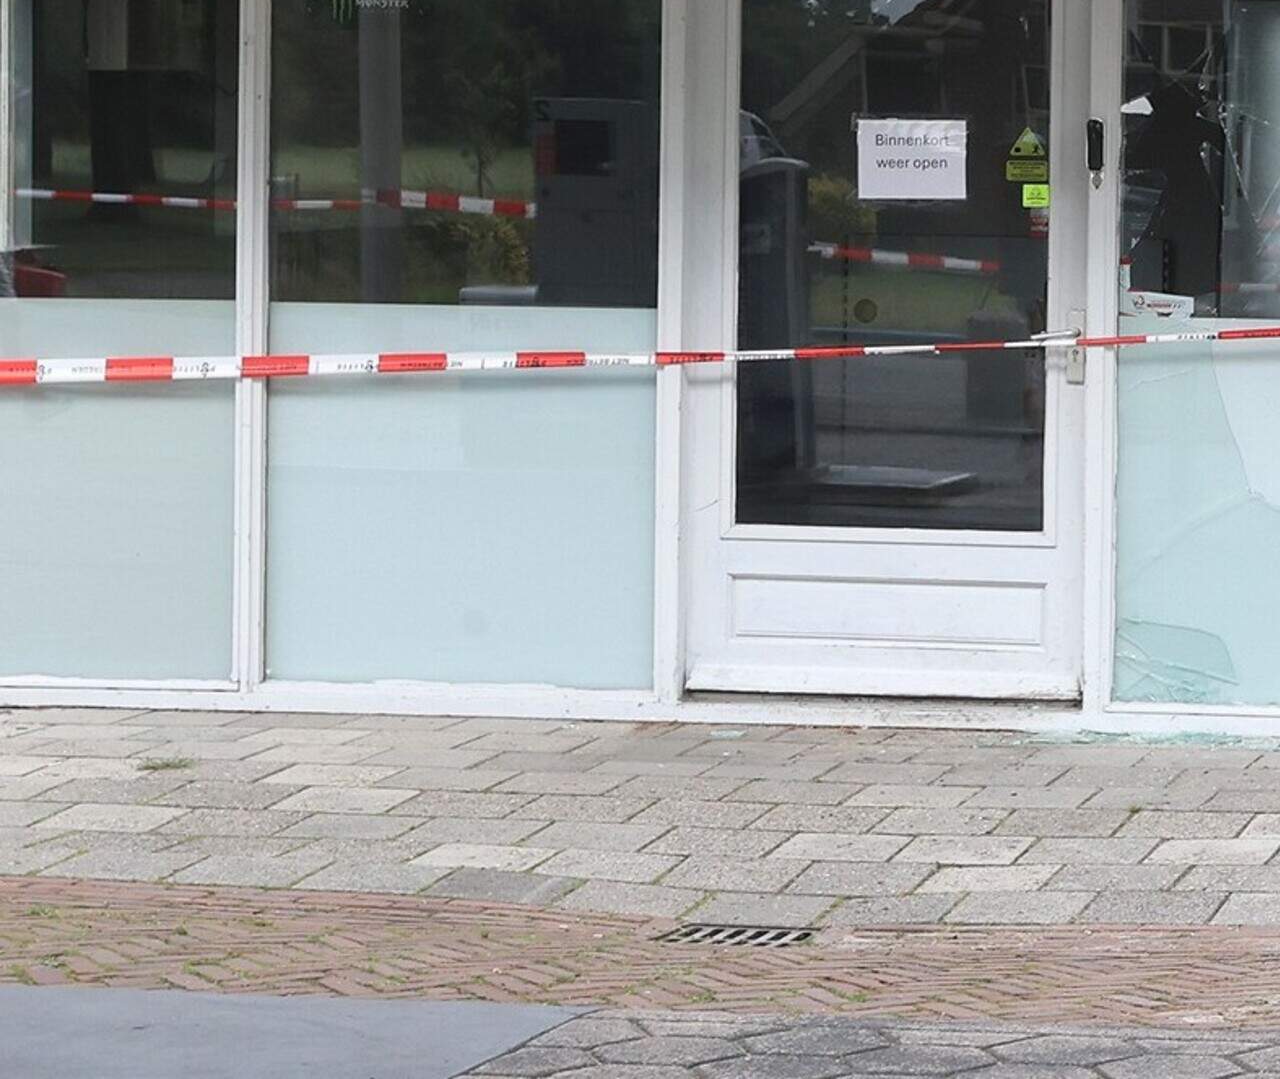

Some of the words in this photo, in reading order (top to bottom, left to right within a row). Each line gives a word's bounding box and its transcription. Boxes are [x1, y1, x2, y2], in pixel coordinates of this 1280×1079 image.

[875, 133, 949, 147] Binnenkort
[876, 158, 911, 169] weer
[912, 158, 948, 171] open
